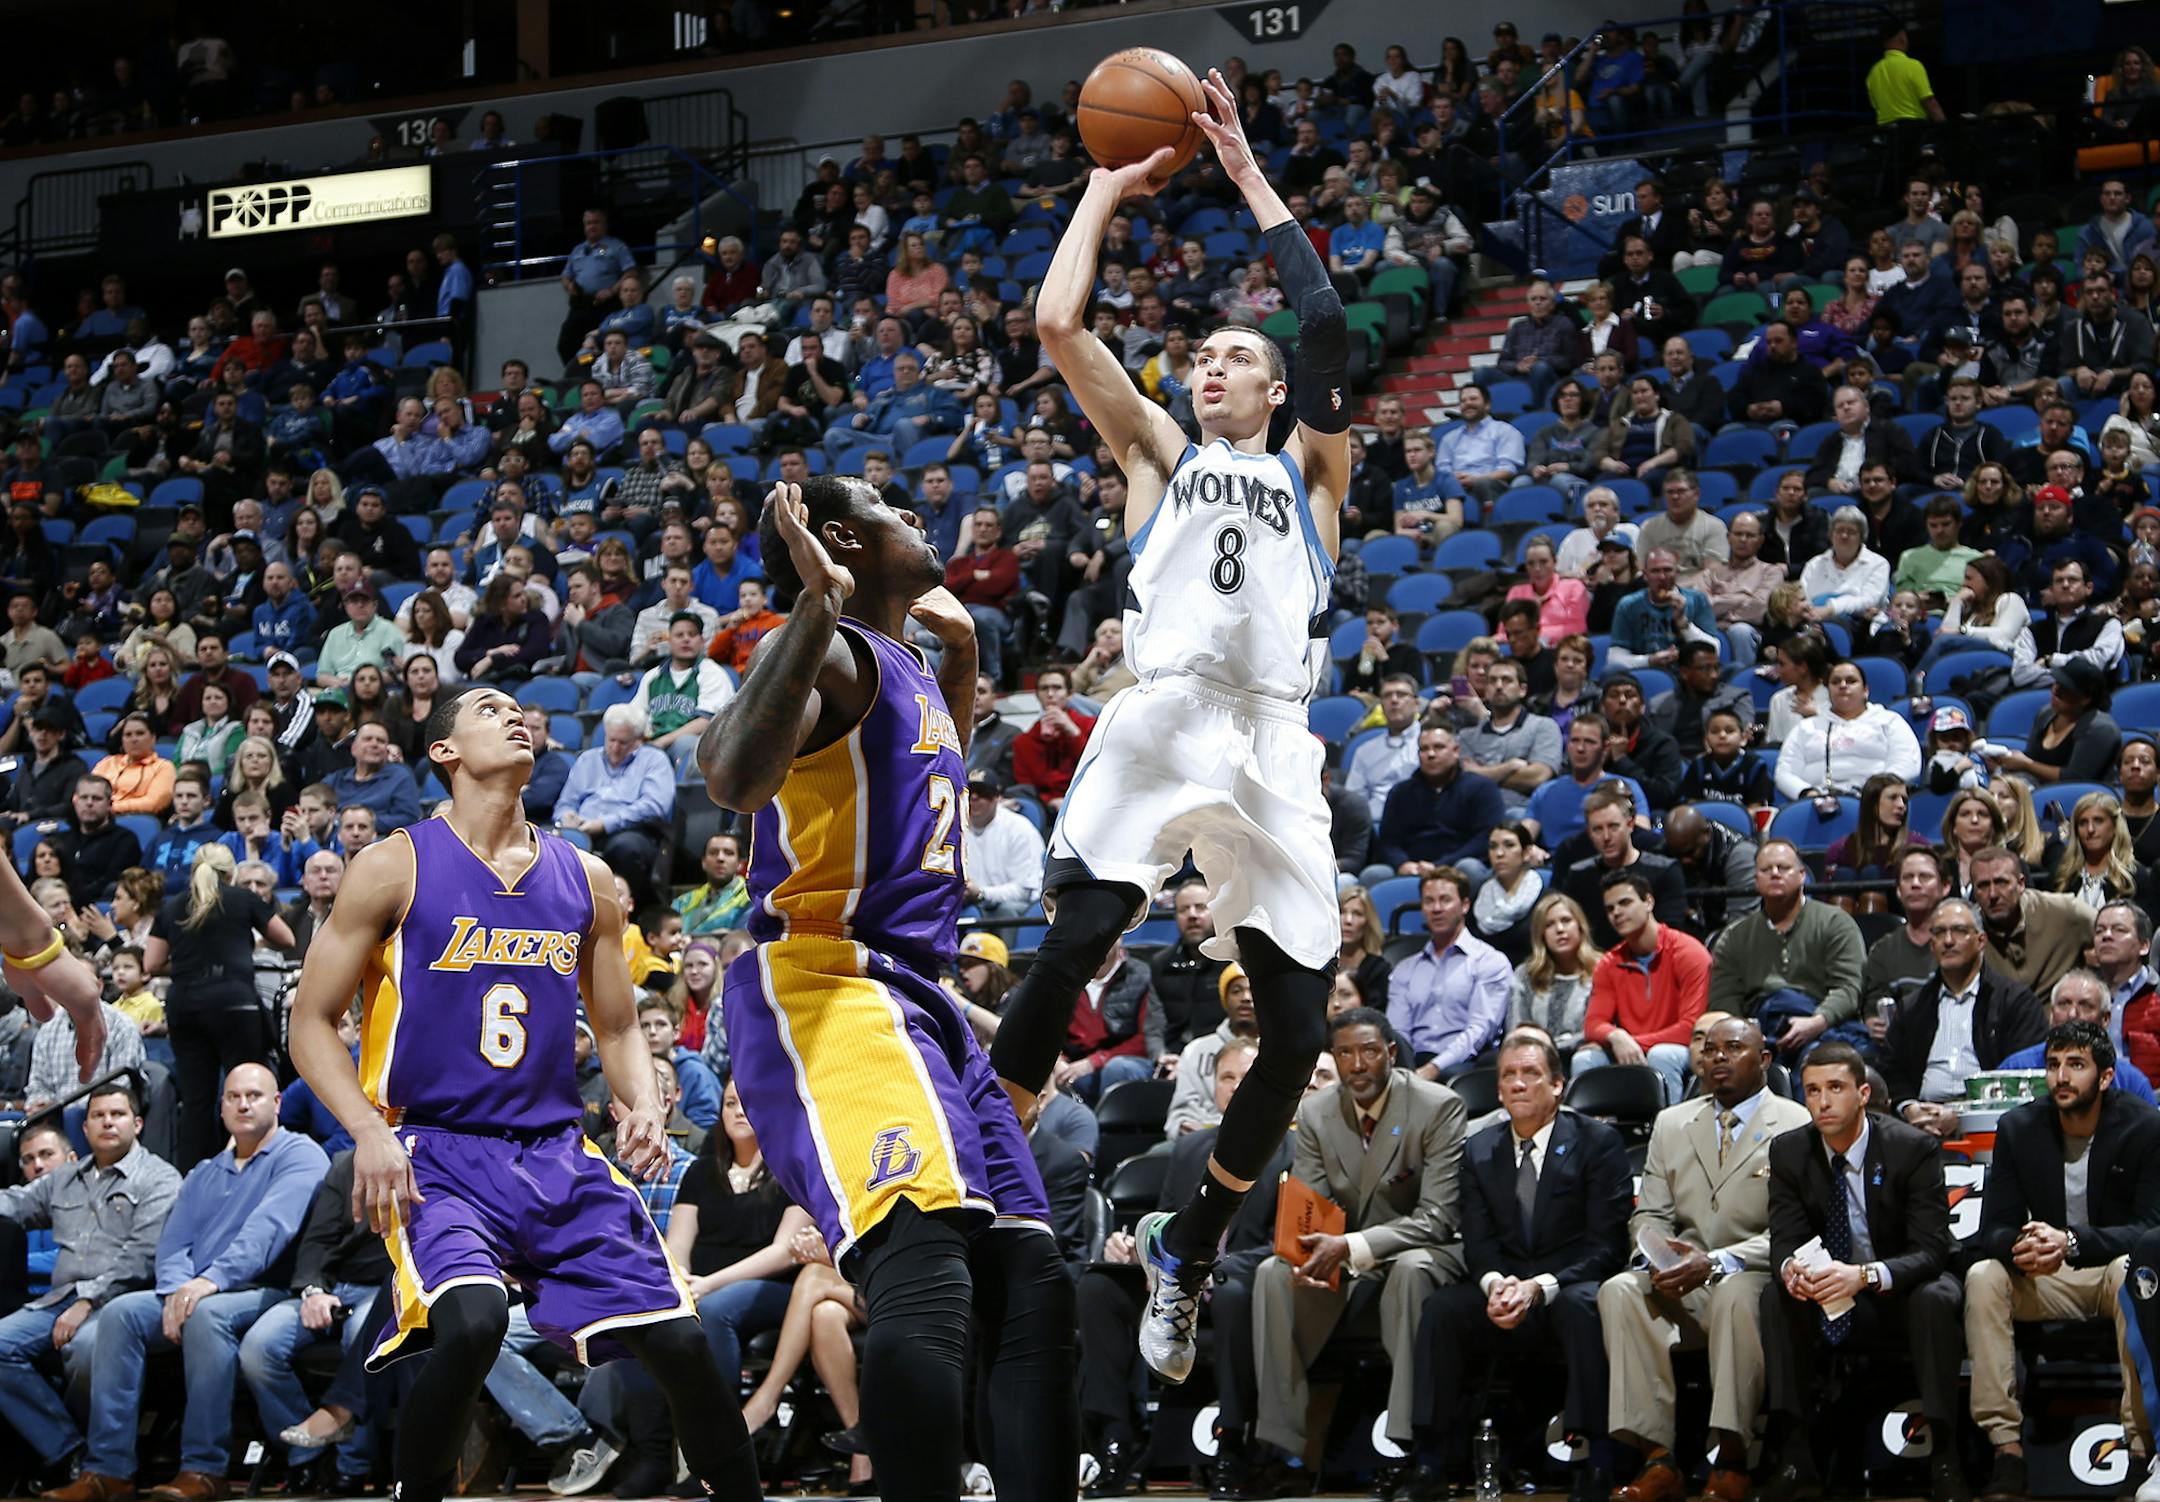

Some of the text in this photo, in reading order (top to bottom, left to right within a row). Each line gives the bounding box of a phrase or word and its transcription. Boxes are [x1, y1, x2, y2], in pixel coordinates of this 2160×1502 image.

[1249, 5, 1299, 35] 131
[213, 184, 427, 232] POPP Communications
[1592, 191, 1634, 216] sun
[1172, 466, 1293, 537] WOLVES
[1210, 524, 1248, 595] 8
[428, 916, 582, 976] LAKERS
[480, 983, 528, 1069] 6
[2069, 1423, 2130, 1486] G
